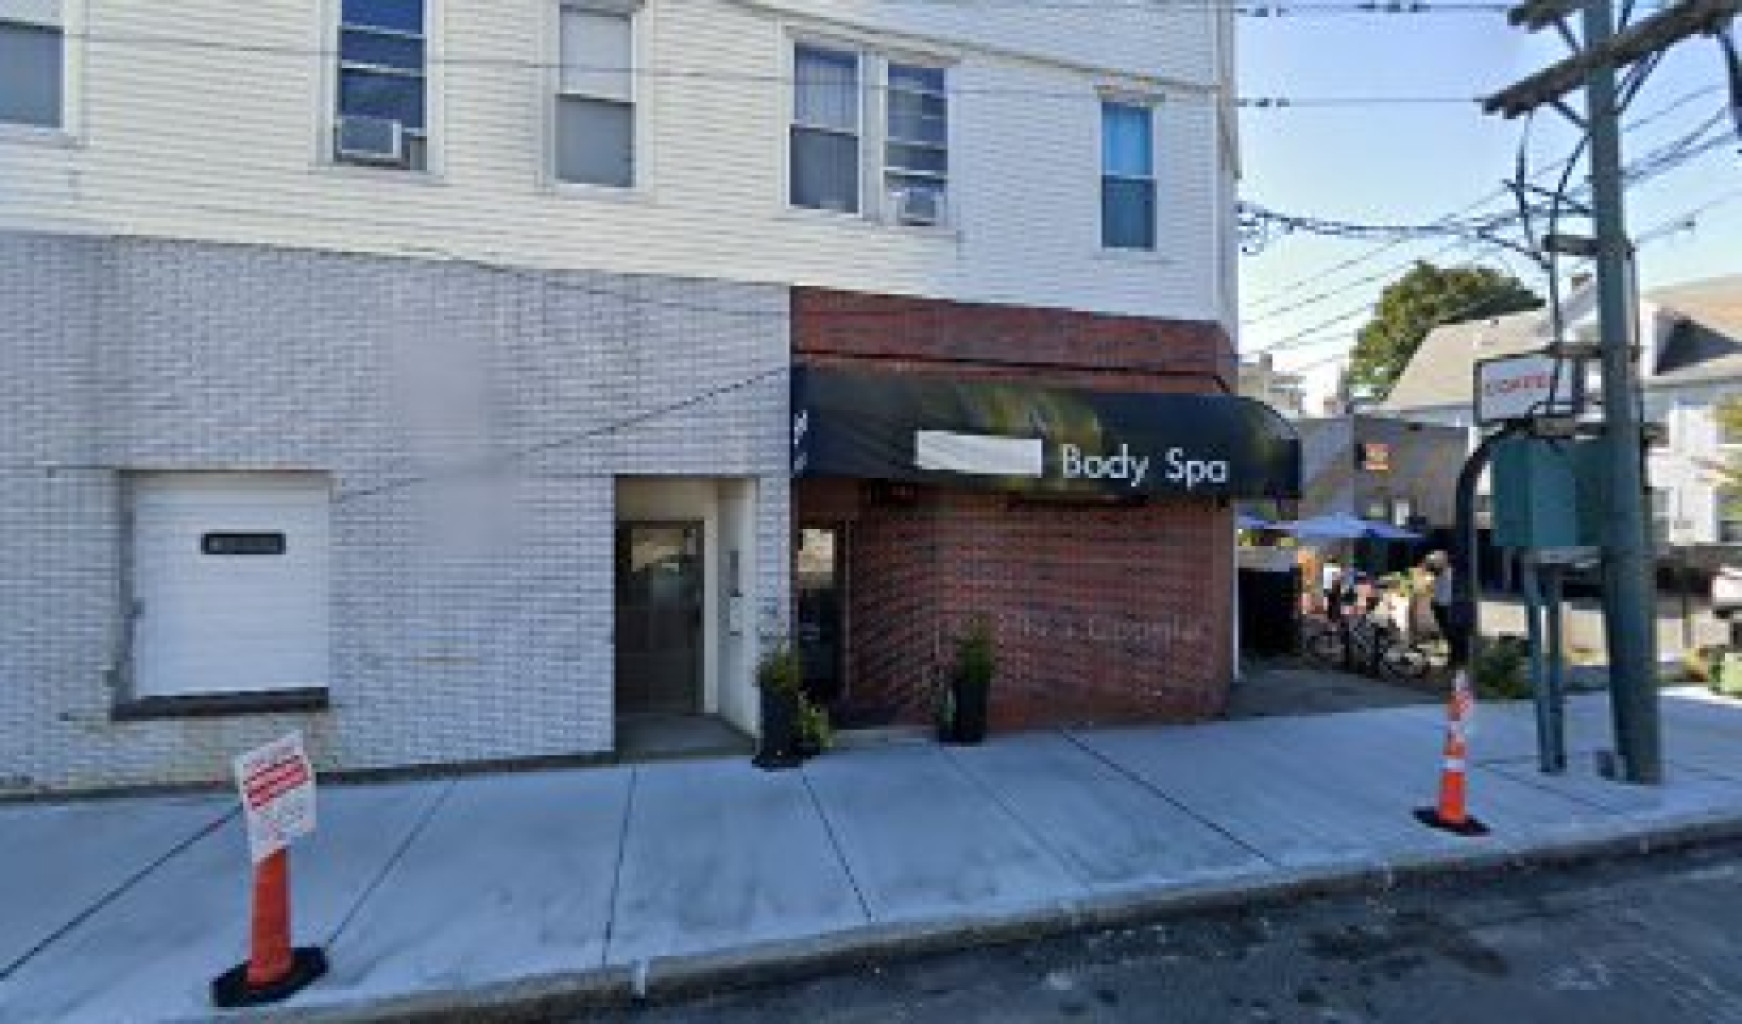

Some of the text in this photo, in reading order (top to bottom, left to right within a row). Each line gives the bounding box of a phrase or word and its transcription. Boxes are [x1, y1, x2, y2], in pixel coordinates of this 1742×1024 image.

[1485, 372, 1557, 397] COFFE
[1061, 443, 1230, 490] Body Spa
